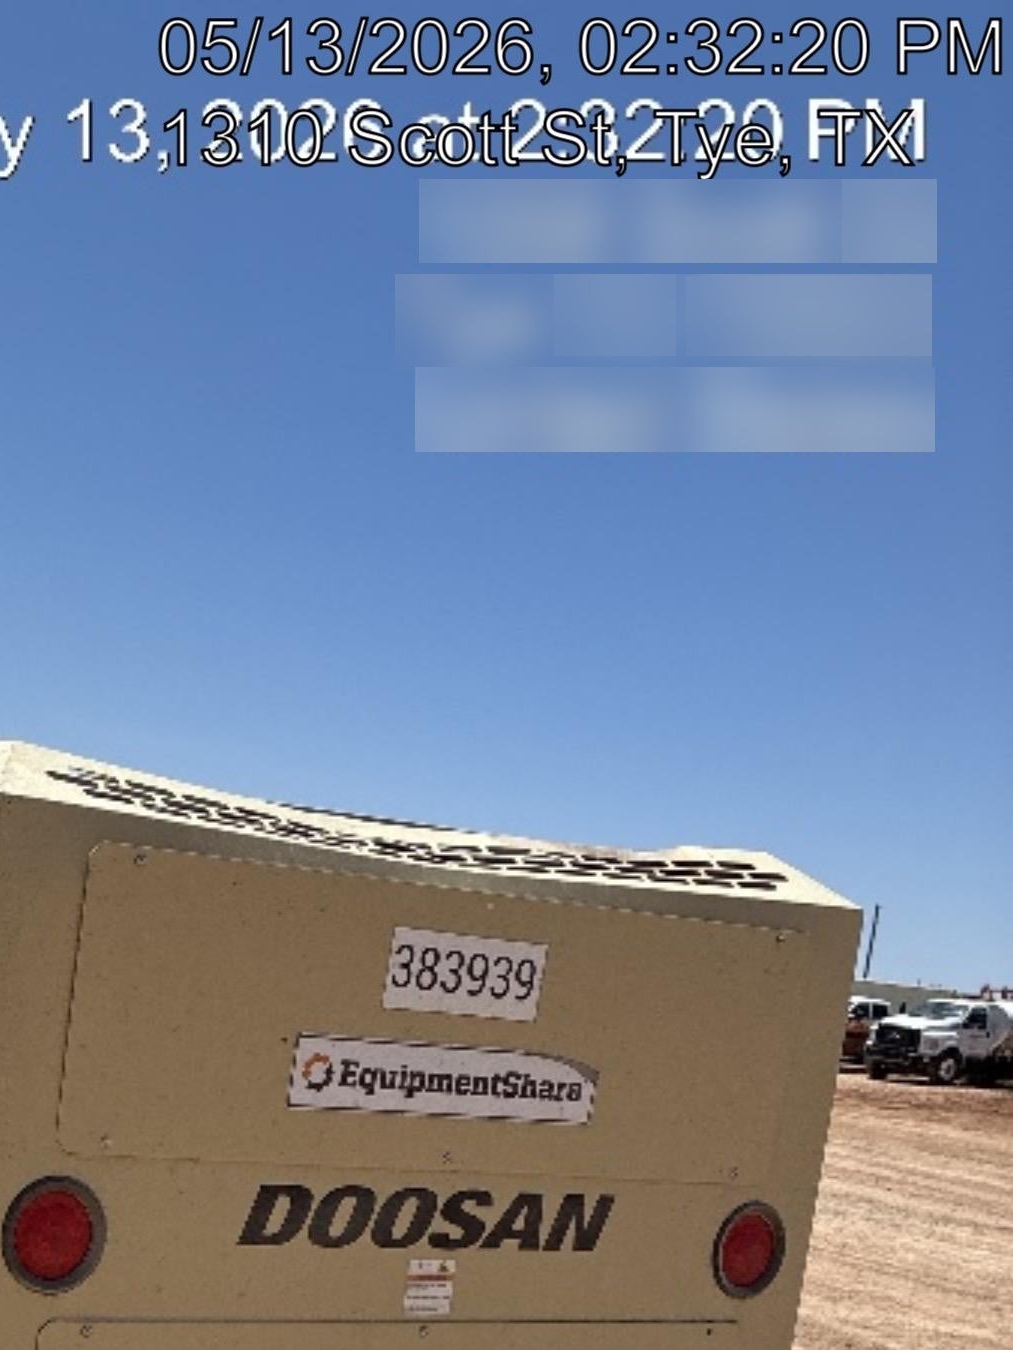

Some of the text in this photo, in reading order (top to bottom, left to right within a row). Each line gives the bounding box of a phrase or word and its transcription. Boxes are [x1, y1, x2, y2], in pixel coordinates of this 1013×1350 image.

[391, 944, 537, 1000] 383939
[338, 1058, 583, 1102] EquipmentShare
[236, 1184, 616, 1252] DOOSAN
